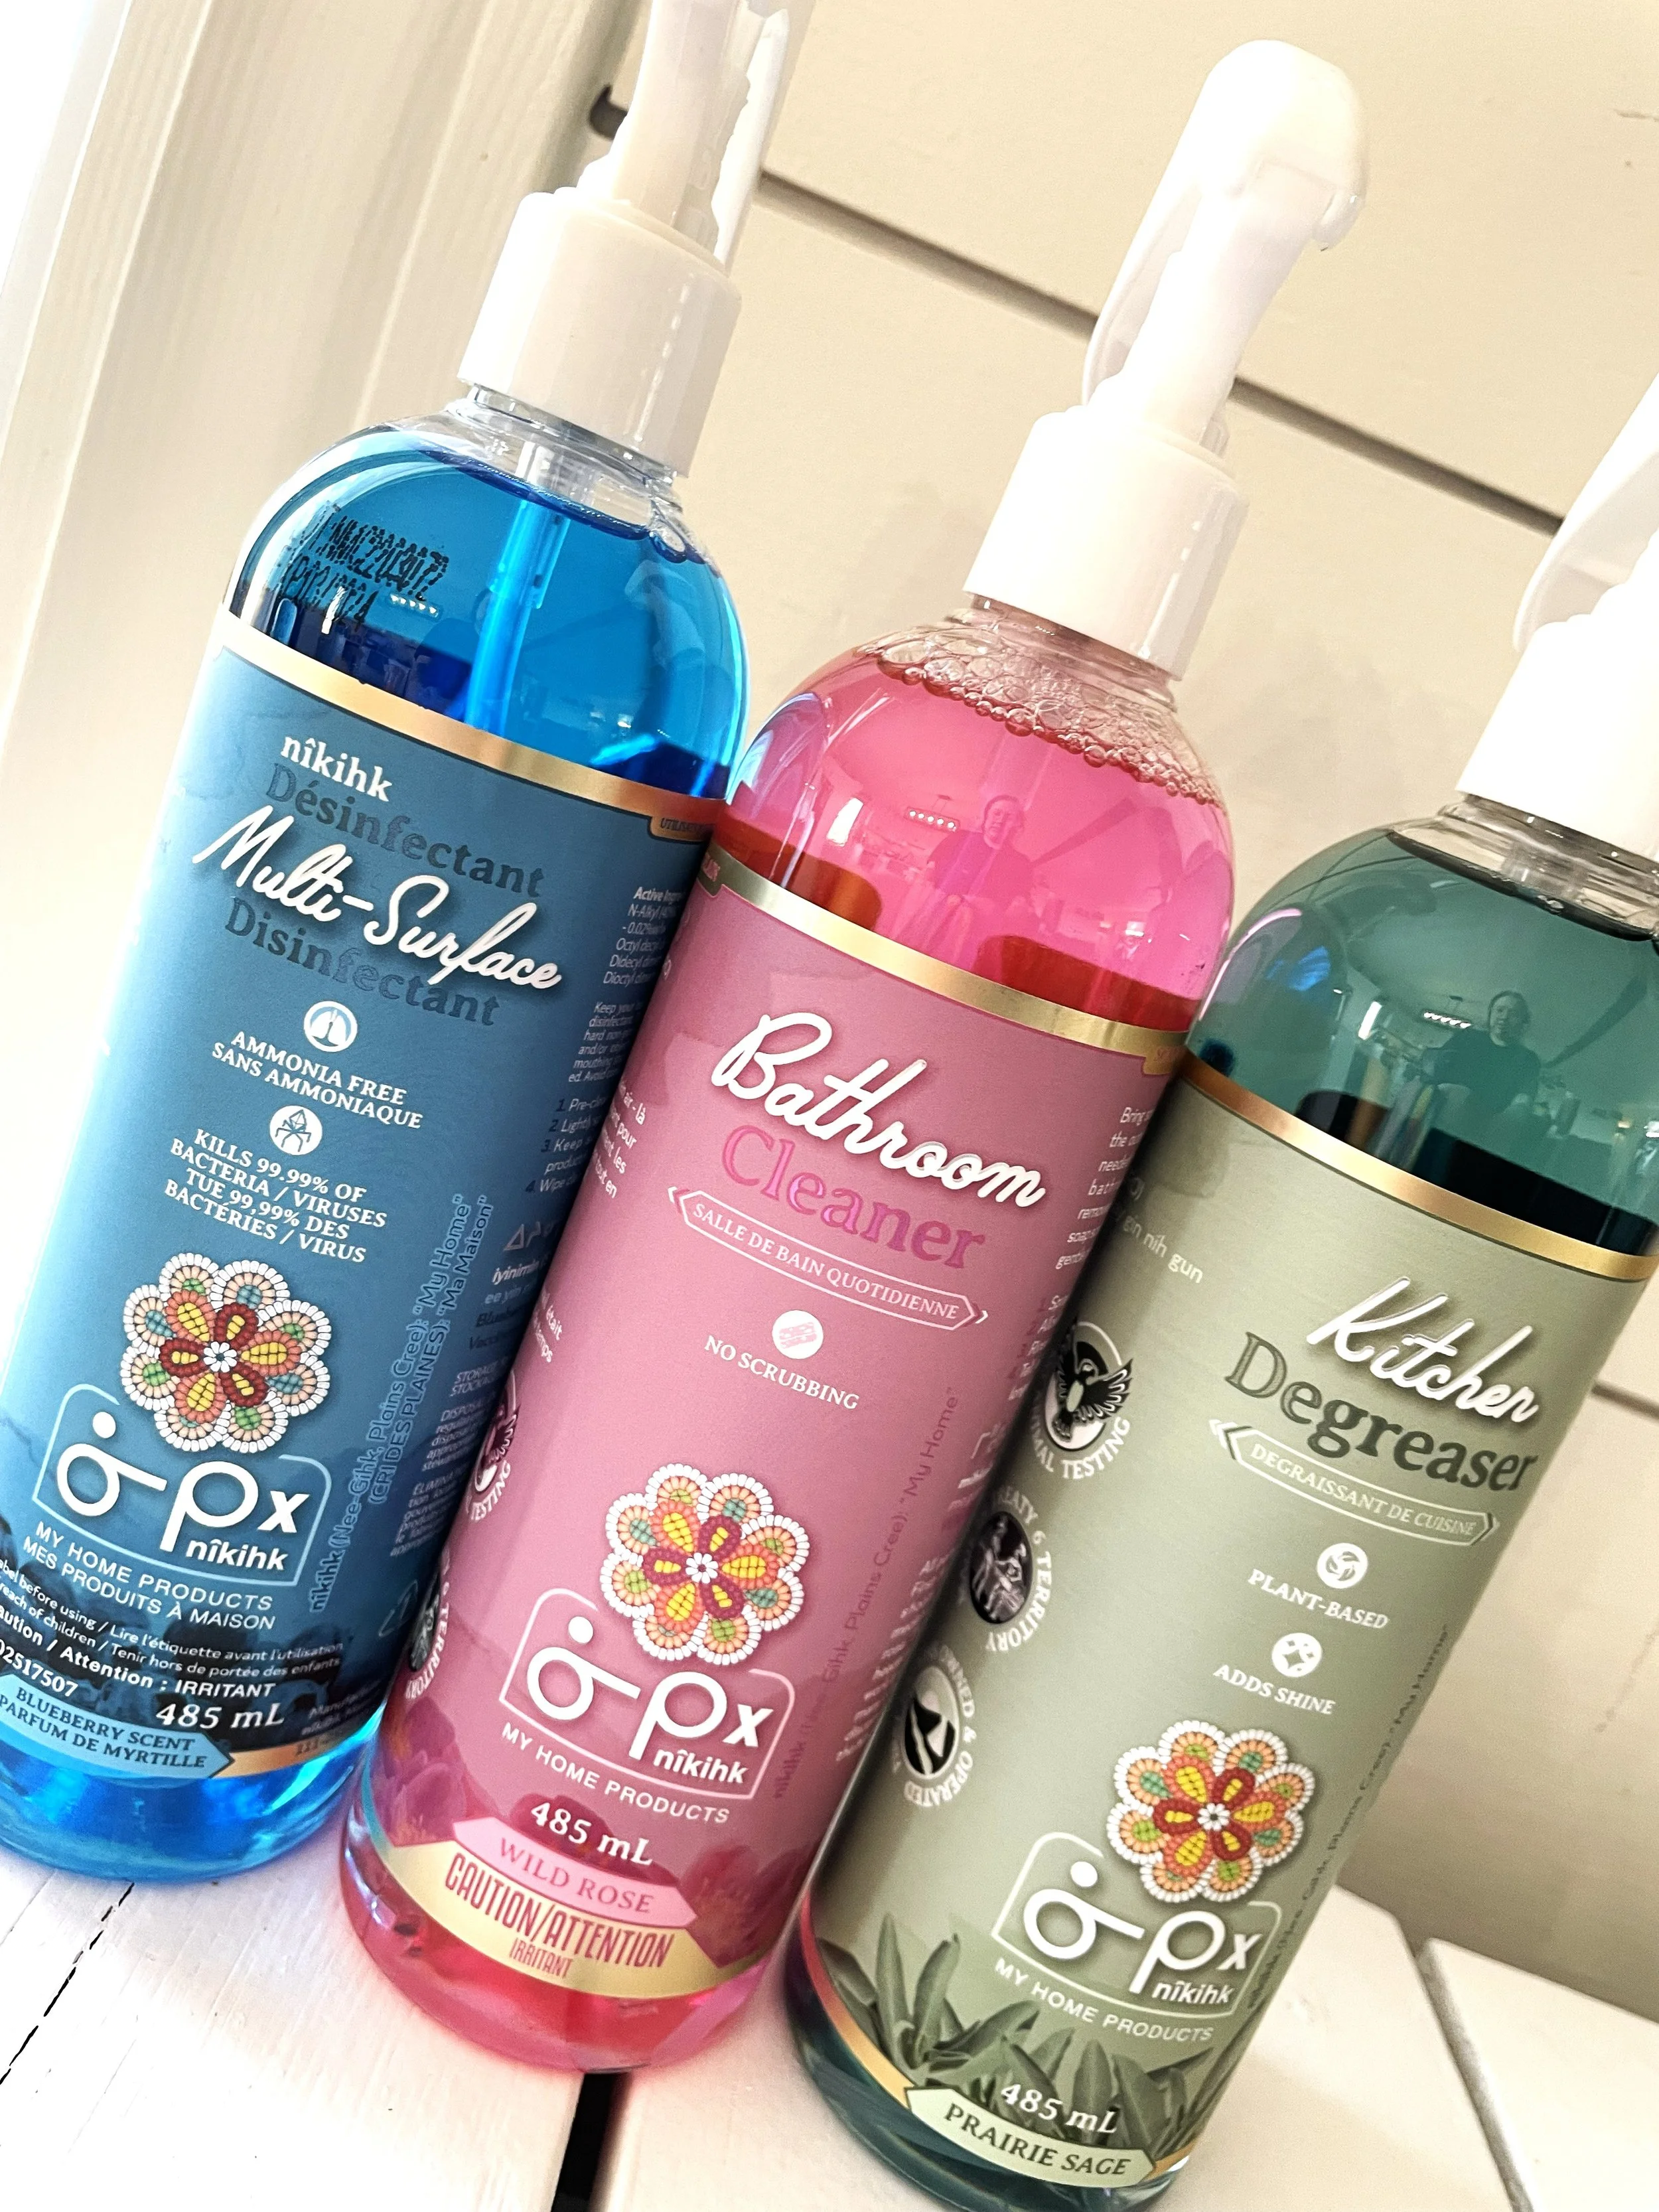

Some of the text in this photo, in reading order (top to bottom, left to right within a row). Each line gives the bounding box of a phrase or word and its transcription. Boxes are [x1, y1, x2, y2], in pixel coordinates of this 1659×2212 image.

[280, 736, 393, 802] nîkihk
[265, 763, 543, 898] Désinfectant
[192, 805, 562, 989] Multi-Surface
[225, 897, 501, 1026] Disinfectant
[212, 1042, 423, 1130] SANS AMMONIAQUE
[230, 1031, 407, 1106] AMMONIA FREE
[711, 1011, 1046, 1208] Bathroom
[171, 1138, 270, 1197] BACTERIA
[293, 1191, 387, 1228] VIRUSES
[194, 1128, 367, 1203] KILLS 99.99% OF
[721, 1124, 986, 1269] Cleaner
[165, 1179, 277, 1241] BACTÉRIES
[299, 1233, 366, 1262] VIRUS
[186, 1167, 224, 1200] TUE
[306, 1215, 350, 1240] DES
[693, 1203, 960, 1321] SALLE DE BAIN QUOTIDIENNE
[1167, 1253, 1203, 1284] gun
[704, 1335, 860, 1410] NO SCRUBBING
[1306, 1276, 1540, 1423] Kitchen
[368, 1380, 405, 1441] Plains
[1062, 1416, 1130, 1479] TESTING
[1224, 1331, 1539, 1492] Degreaser
[1250, 1443, 1477, 1536] DEGRAISSANT DE CUISINE
[23, 1536, 58, 1570] MES
[61, 1564, 163, 1615] PRODUITS
[190, 1609, 276, 1631] MAISON
[36, 1521, 273, 1611] MY HOME PRODUCTS
[186, 1538, 289, 1571] nîkihk
[19, 1574, 58, 1609] before
[60, 1606, 96, 1631] using
[110, 1625, 139, 1643] Lire
[224, 1651, 267, 1660] avant
[985, 1551, 1052, 1652] TERRITORY
[1248, 1568, 1390, 1629] PLANT-BASED
[29, 1607, 45, 1619] of
[44, 1615, 96, 1648] children
[111, 1643, 147, 1663] Tenir
[150, 1655, 182, 1672] hors
[187, 1663, 205, 1674] de
[263, 1666, 288, 1676] des
[291, 1658, 341, 1674] enfants
[60, 1646, 153, 1688] Attention
[175, 1680, 276, 1698] IRRITANT
[16, 1686, 195, 1752] BLUEBERRY SCENT
[156, 1703, 222, 1729] 485
[230, 1703, 285, 1728] mL
[1213, 1664, 1336, 1715] ADDS SHINE
[0, 1694, 206, 1769] PARFUM DE MYRTILLE
[654, 1749, 749, 1784] nîkihk
[502, 1722, 730, 1825] MY HOME PRODUCTS
[530, 1802, 654, 1866] 485 mL
[444, 1852, 676, 1968] CAUTION/ATTENTION
[500, 1837, 654, 1914] WILD ROSE
[509, 1937, 574, 1979] IRRITANT
[1152, 1980, 1234, 2005] nîkihk
[995, 1957, 1214, 2042] MY HOME PRODUCTS
[945, 2102, 1131, 2175] PRAIRIE SAGE
[1001, 2083, 1118, 2134] 485 mL
